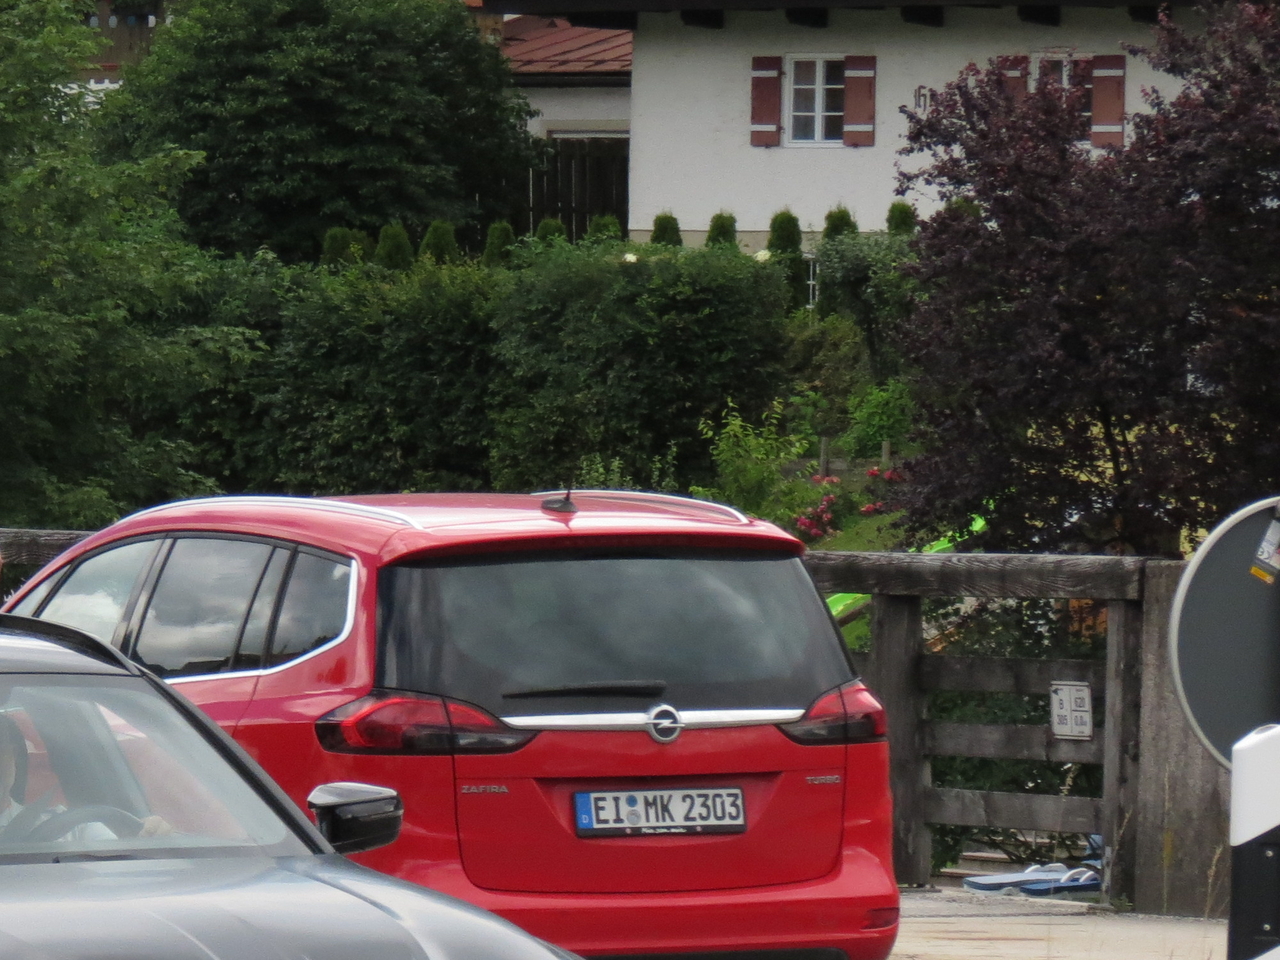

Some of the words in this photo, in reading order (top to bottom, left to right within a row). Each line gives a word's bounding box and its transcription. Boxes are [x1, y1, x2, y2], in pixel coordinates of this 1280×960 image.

[805, 774, 842, 785] TURBO
[461, 784, 510, 794] ZAFIRA
[581, 814, 589, 824] D
[593, 796, 625, 825] EI
[643, 794, 676, 823] MK
[682, 792, 741, 823] 2303
